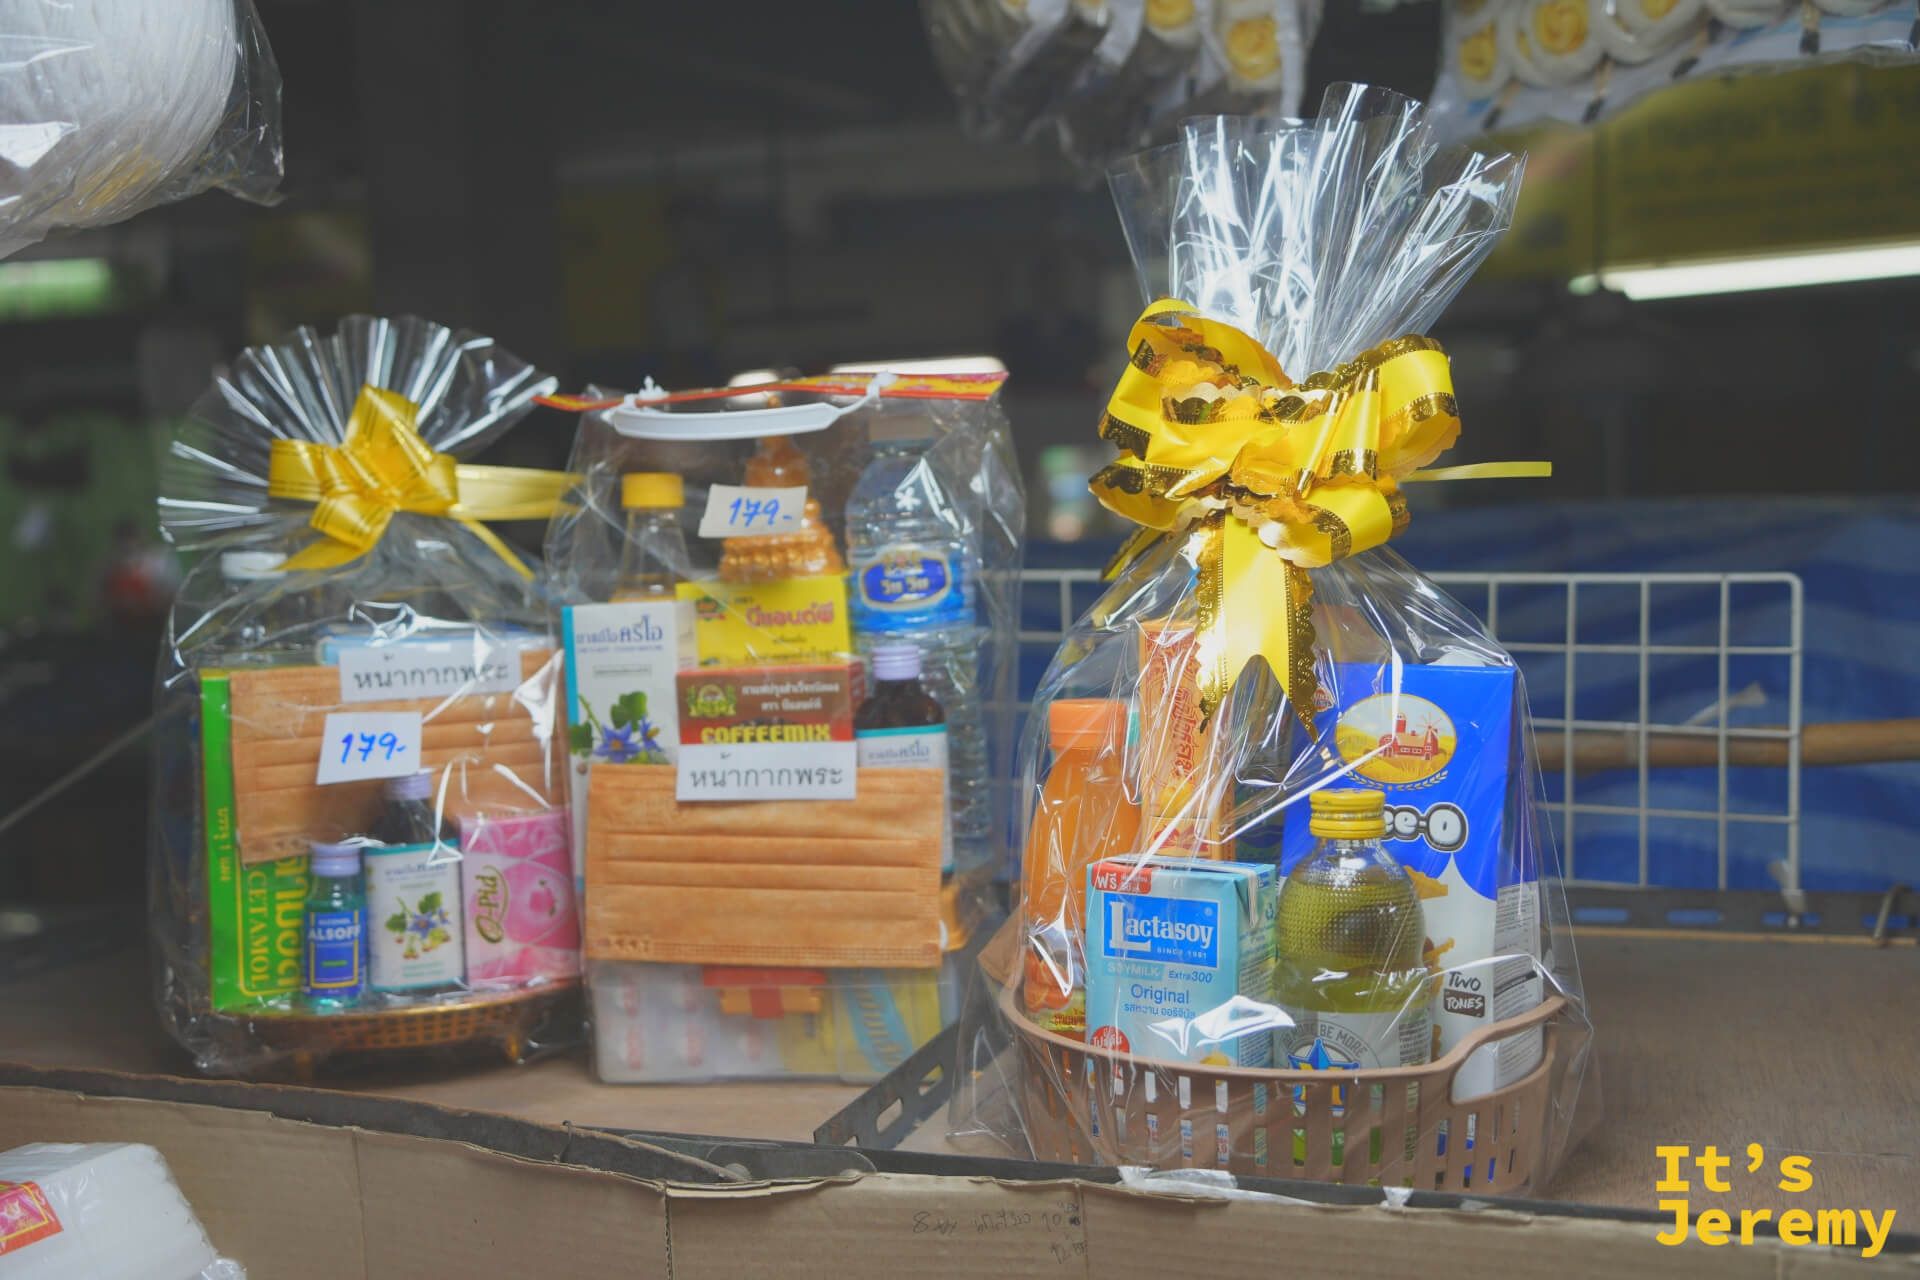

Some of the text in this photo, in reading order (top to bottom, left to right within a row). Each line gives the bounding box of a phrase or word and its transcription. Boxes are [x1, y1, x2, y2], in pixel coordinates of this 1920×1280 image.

[701, 723, 832, 744] COFFEEMIX
[690, 751, 844, 788] หน้ากากพระ
[308, 924, 361, 941] ALSOFF
[1109, 901, 1214, 952] Lactasoy
[1130, 983, 1190, 1005] Original
[1445, 995, 1484, 1011] TONES
[1319, 1023, 1335, 1039] BE
